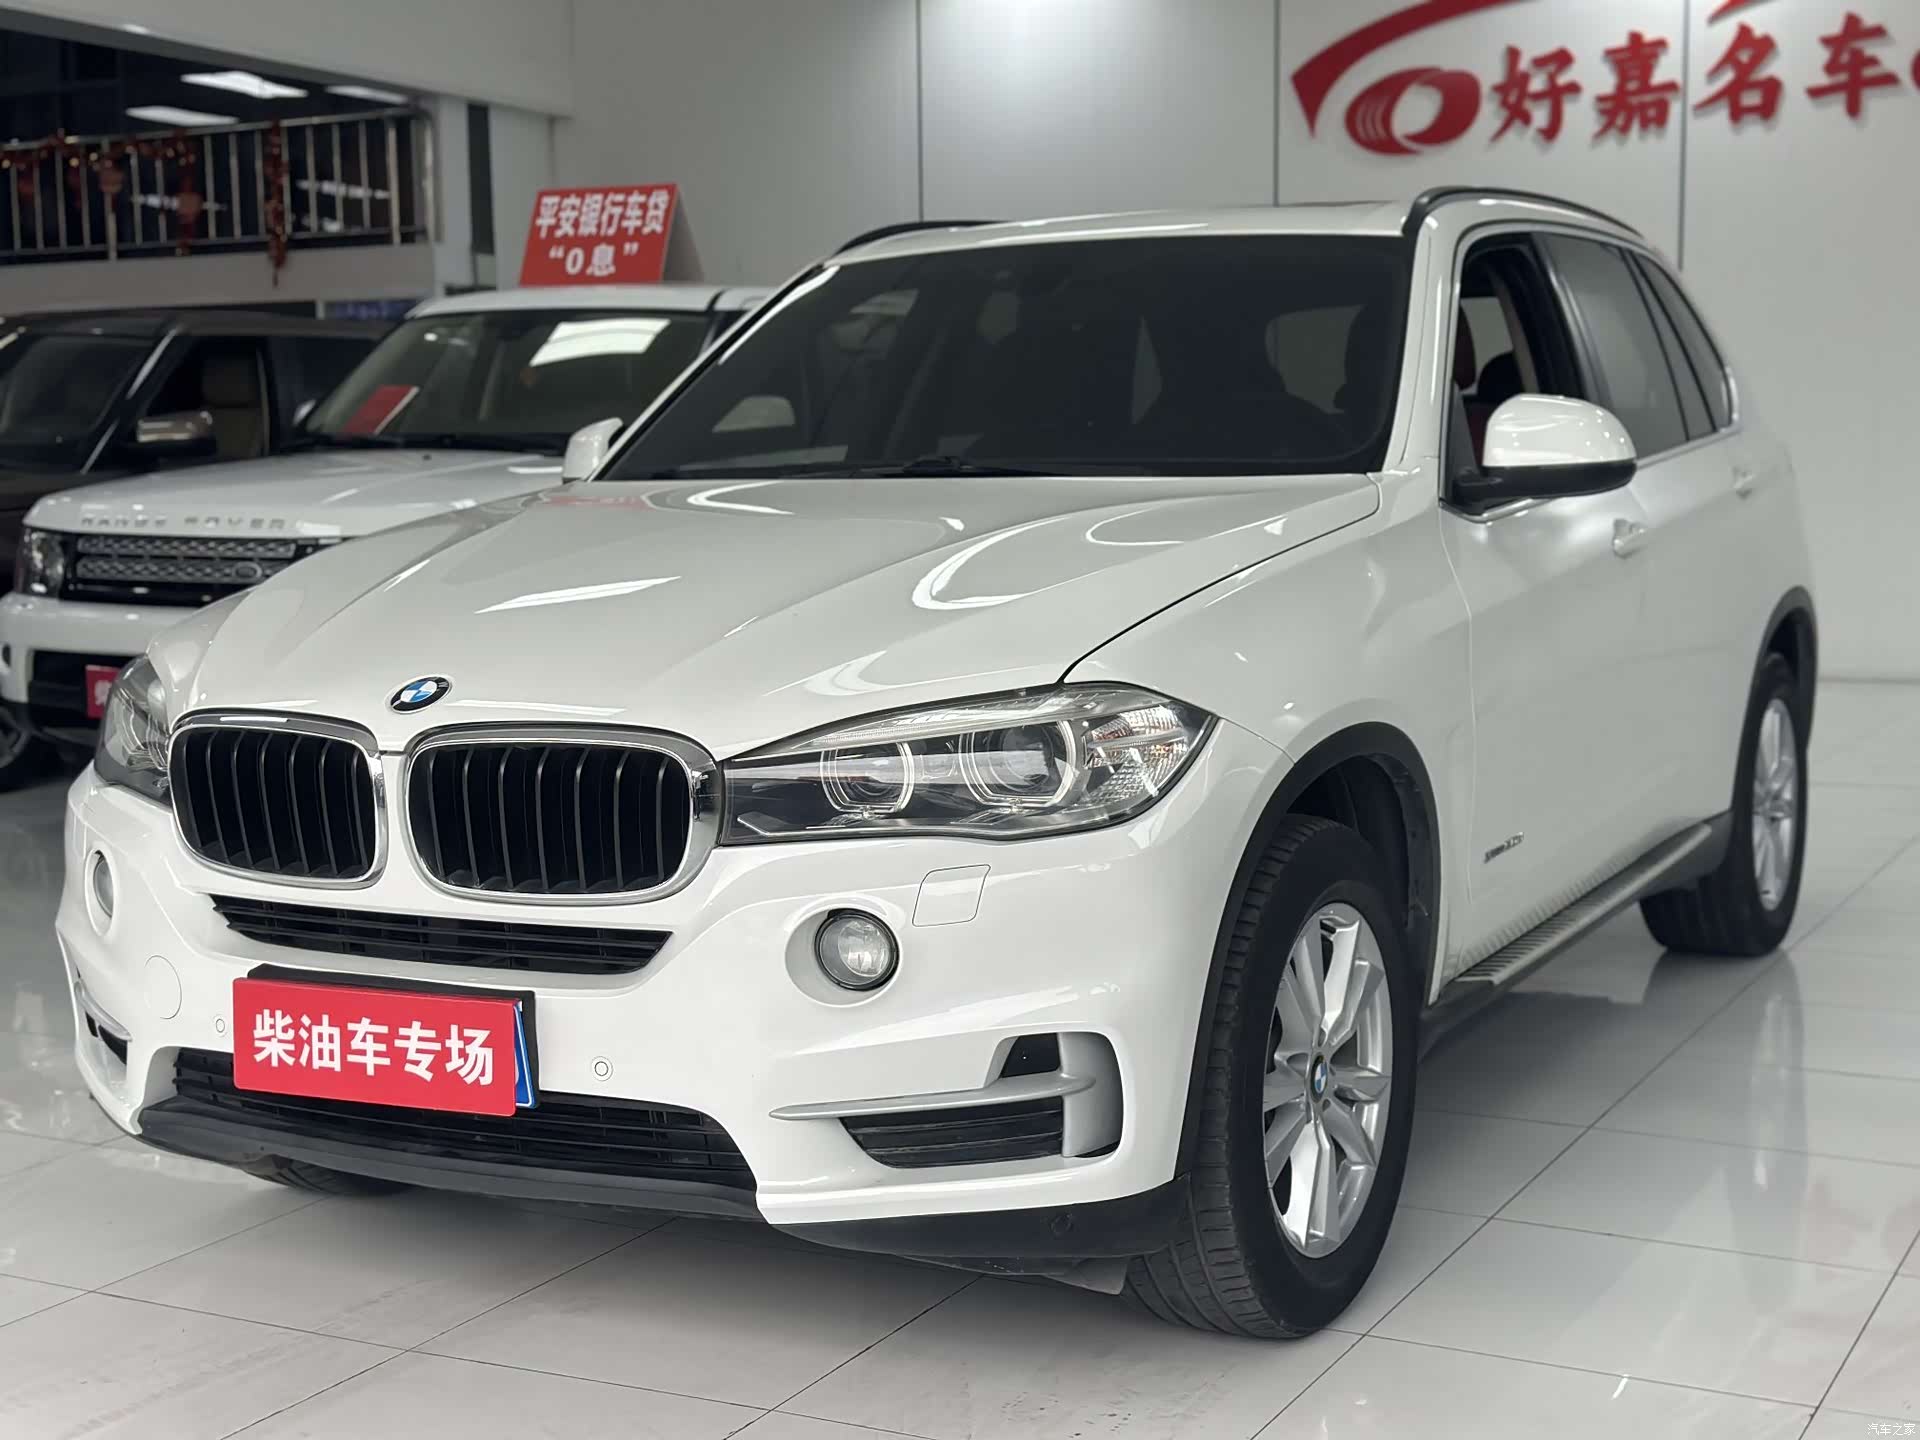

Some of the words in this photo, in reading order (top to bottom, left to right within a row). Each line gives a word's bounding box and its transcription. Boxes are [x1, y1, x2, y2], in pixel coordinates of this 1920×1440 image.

[1487, 12, 1901, 147] 好嘉名车
[535, 189, 670, 240] 平安银行车贷
[252, 1008, 494, 1086] 柴油车专场
